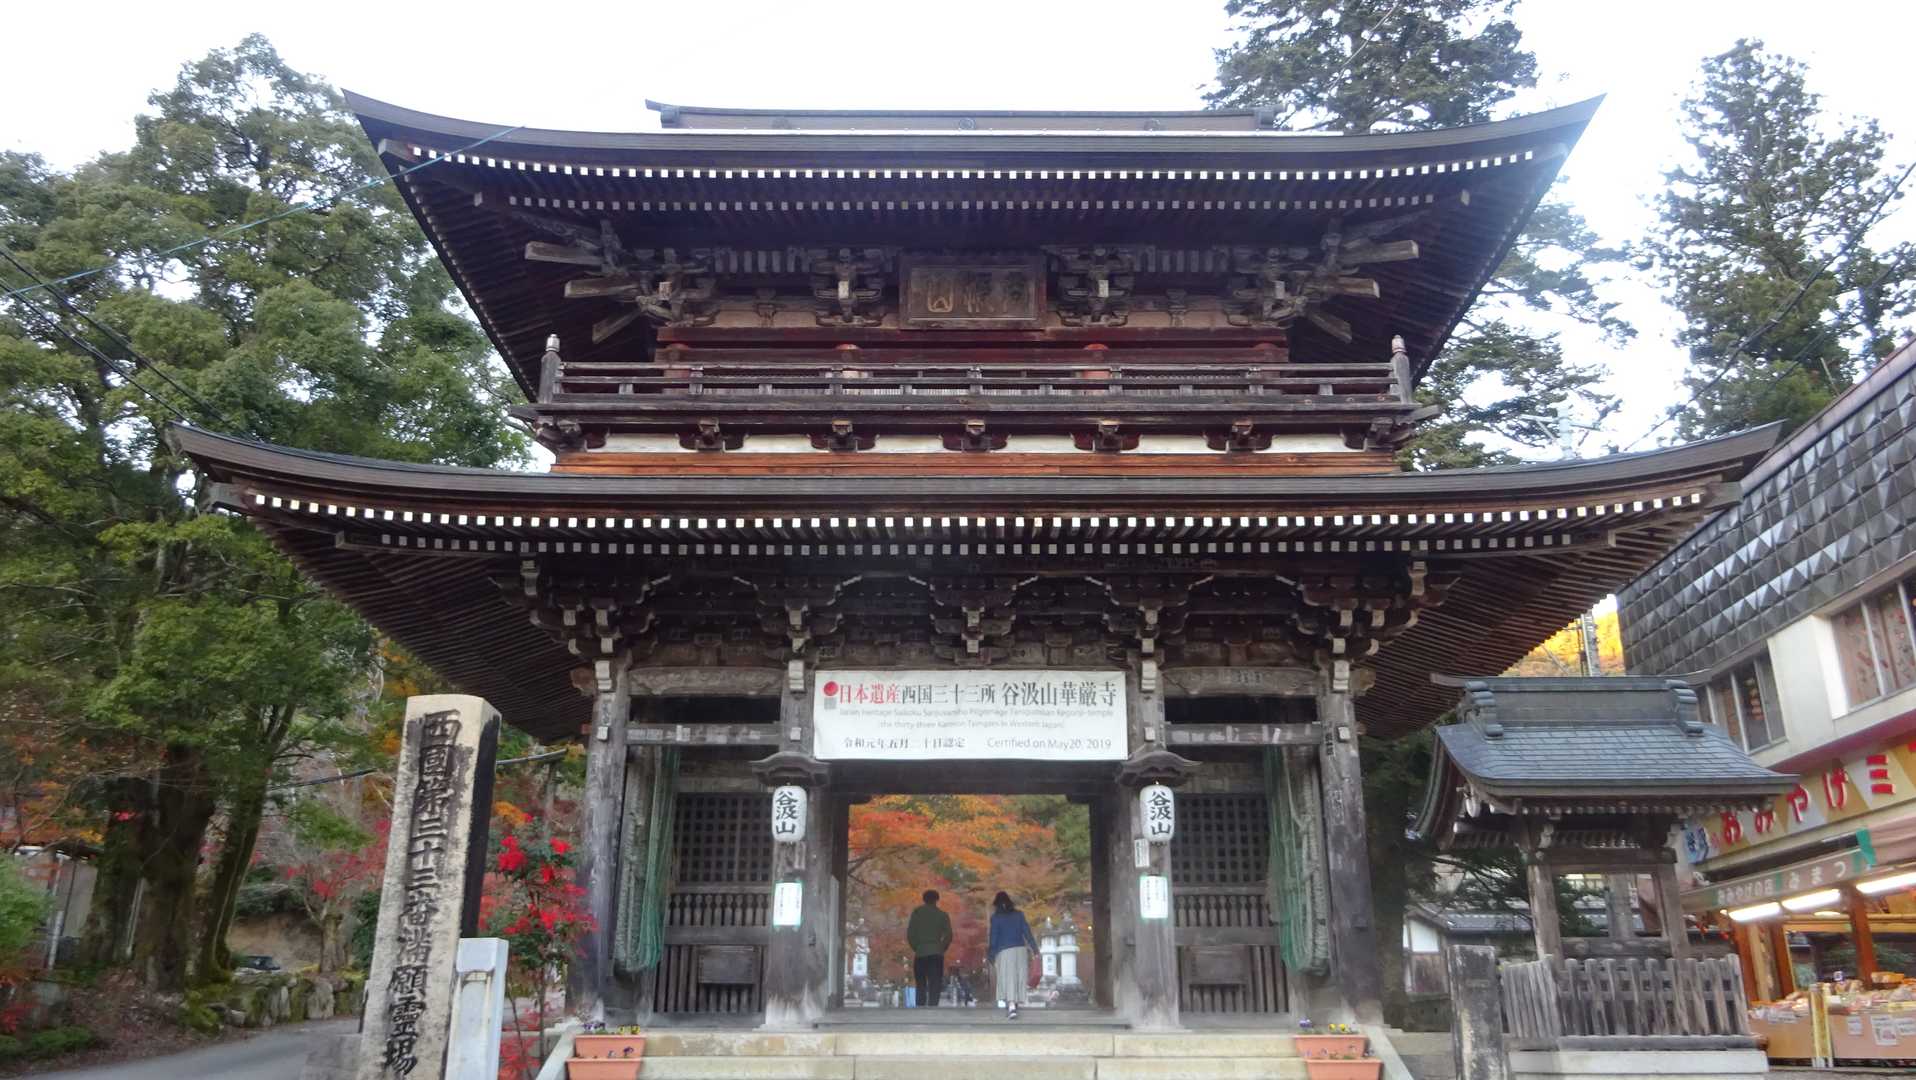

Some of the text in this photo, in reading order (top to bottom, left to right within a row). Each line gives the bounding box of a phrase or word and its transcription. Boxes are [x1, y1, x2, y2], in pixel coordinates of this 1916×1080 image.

[839, 682, 1117, 706] 日本遺産西国三十三所 谷汲山華厳寺
[987, 737, 1031, 749] Certified
[1033, 740, 1046, 749] on
[1086, 738, 1112, 750] 2019
[775, 791, 799, 834] 谷汲山
[1149, 791, 1173, 836] 谷汲山
